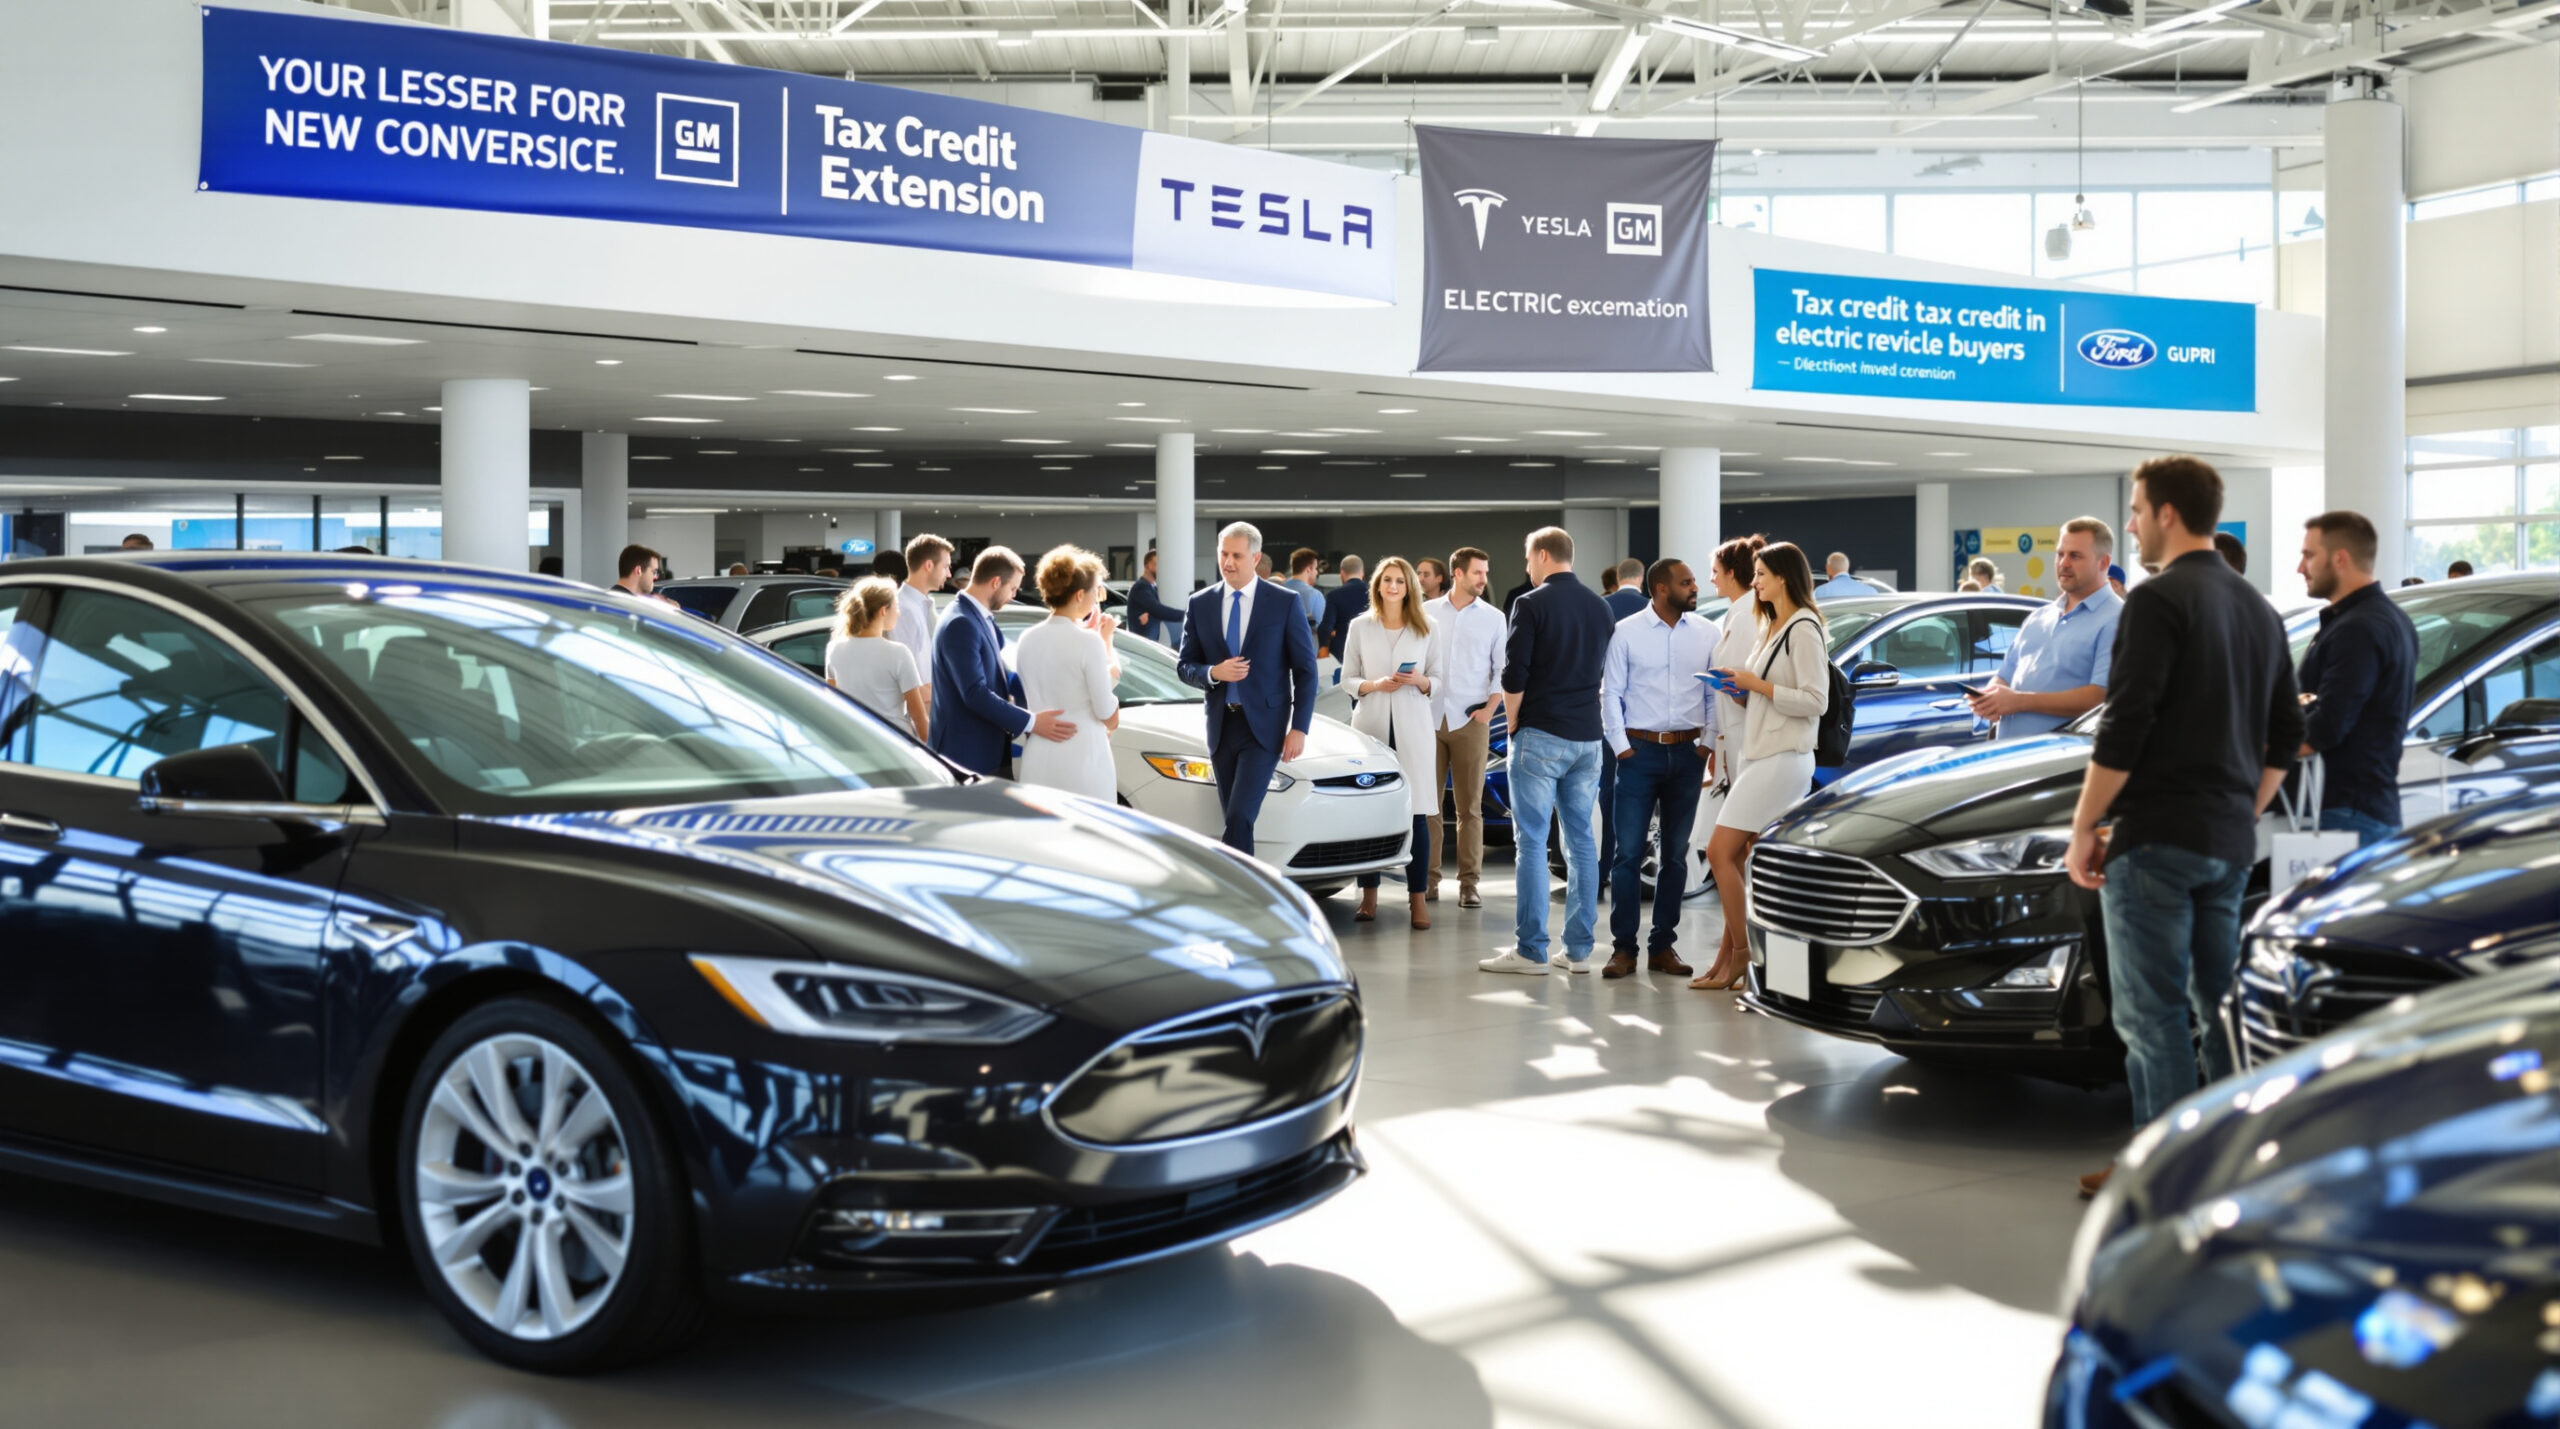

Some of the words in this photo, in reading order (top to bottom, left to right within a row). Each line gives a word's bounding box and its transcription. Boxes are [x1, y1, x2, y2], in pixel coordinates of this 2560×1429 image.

[259, 55, 366, 99] YOUR
[378, 67, 517, 115] LESSER
[530, 84, 626, 128] FORR
[265, 108, 362, 151] NEW
[375, 118, 624, 176] CONVERSICE.
[675, 119, 720, 150] GM
[815, 104, 887, 152] Tax
[895, 115, 1017, 171] Credit
[821, 155, 1045, 224] Extension
[1160, 177, 1373, 249] TESLA
[1521, 215, 1592, 238] YESLA
[1617, 217, 1653, 242] GM
[1444, 288, 1562, 315] ELECTRIC
[1791, 288, 1834, 317] Tax
[1839, 295, 1909, 322] credit
[1914, 301, 1952, 325] tax
[1957, 304, 2022, 331] credit
[2026, 307, 2046, 332] in
[1775, 320, 1863, 350] electric
[1867, 330, 1944, 356] revicle
[1948, 332, 2025, 365] buyers
[2089, 334, 2145, 364] Ford
[2167, 345, 2216, 365] GUPRI
